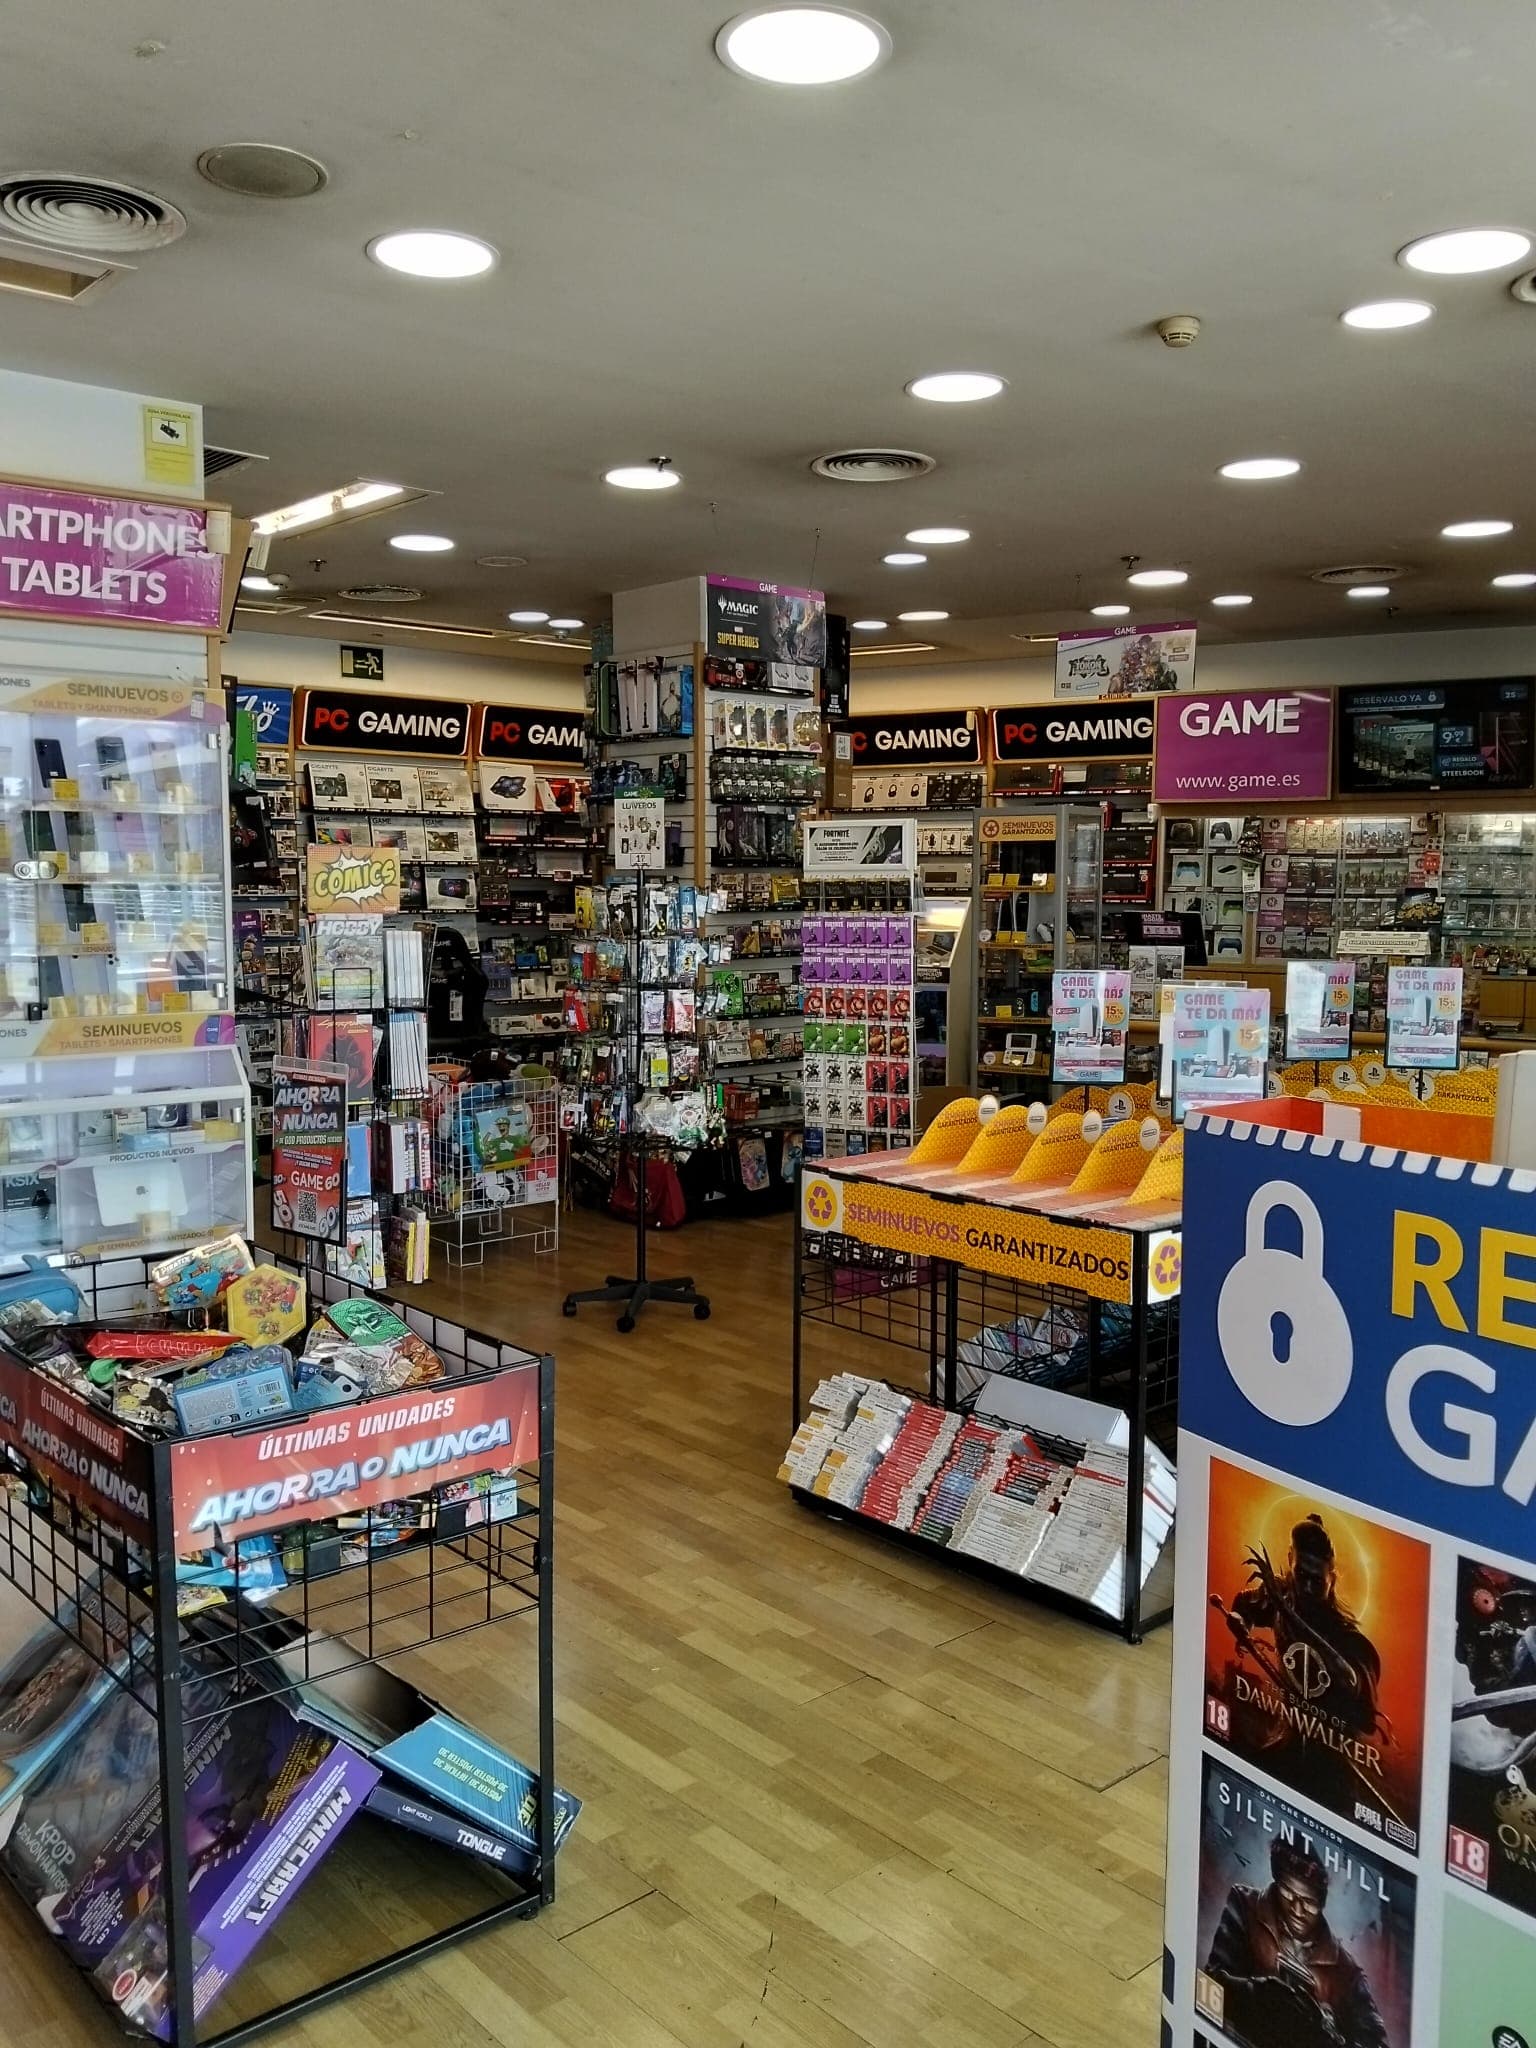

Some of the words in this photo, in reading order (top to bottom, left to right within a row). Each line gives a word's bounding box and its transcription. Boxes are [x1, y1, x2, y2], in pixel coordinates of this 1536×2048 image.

[1, 556, 167, 605] TABLETS
[759, 583, 778, 594] GAME
[727, 601, 759, 615] MAGIC
[717, 632, 737, 645] SUPER
[737, 635, 760, 649] HEROES
[1114, 626, 1137, 636] GAME
[67, 682, 169, 702] SEMINUEVOS
[1409, 693, 1422, 703] YA
[84, 703, 160, 716] SMARTPHONES
[1179, 698, 1301, 737] GAME
[314, 707, 349, 731] PC
[358, 711, 461, 739] GAMING
[490, 721, 521, 744] PC
[1004, 723, 1037, 744] PC
[1046, 717, 1154, 743] GAMING
[852, 731, 868, 751] C
[875, 727, 971, 751] GAMING
[1176, 774, 1301, 792] www.game.es
[823, 829, 850, 838] FORTNITE
[1001, 828, 1054, 836] GARANTIZADOS
[1002, 820, 1054, 829] SEMINUEVOS
[314, 859, 397, 897] COMICS
[1061, 976, 1094, 987] GAME
[1396, 970, 1427, 980] GAME
[1062, 988, 1075, 999] TE
[1079, 988, 1096, 999] DA
[1397, 981, 1409, 991] TE
[1413, 981, 1429, 991] DA
[1183, 993, 1225, 1006] GAME
[1185, 1007, 1201, 1020] TE
[1206, 1007, 1227, 1020] DA
[1231, 1004, 1262, 1020] MÁS
[82, 1021, 183, 1038] SEMINUEVOS
[109, 1034, 184, 1048] SMARTPHONES
[1080, 1070, 1099, 1078] GAME
[1285, 1075, 1331, 1084] GARANTIZDOS
[275, 1085, 341, 1106] AHORRA
[282, 1112, 339, 1131] NUNCA
[296, 1134, 327, 1145] PRODUCTOS
[109, 1150, 160, 1162] PRODUCTOS
[161, 1147, 195, 1158] NUEVOS
[6, 1173, 40, 1188] KSIX
[290, 1170, 324, 1191] GAME
[848, 1203, 961, 1243] SEMINUEVOS
[965, 1228, 1129, 1281] GARANTIZADOS
[1391, 1209, 1536, 1350] RE
[40, 1387, 75, 1427] ÚLTIMAS
[76, 1413, 120, 1457] UNIDADES
[258, 1422, 352, 1461] ÚLTIMAS
[358, 1397, 455, 1439] UNIDADES
[22, 1418, 78, 1474] AHORRA
[90, 1460, 150, 1520] NUNCA
[190, 1461, 361, 1534] AHORRA
[389, 1417, 511, 1478] NUNCA
[1265, 1680, 1285, 1698] THE
[1289, 1692, 1328, 1721] BLOOD
[1330, 1715, 1347, 1729] OF
[1206, 1699, 1229, 1732] 18
[1235, 1674, 1384, 1777] DAWNWALKER
[402, 1804, 416, 1816] LIGHT
[416, 1810, 433, 1823] WORLD
[1258, 1790, 1277, 1804] DAY
[1280, 1802, 1299, 1818] ONE
[1303, 1817, 1344, 1845] EDITION
[16, 1821, 43, 1863] DEMON
[35, 1819, 76, 1865] KPOP
[456, 1829, 507, 1861] TONGUE
[1218, 1782, 1314, 1857] SILENT
[1325, 1846, 1391, 1903] HILL
[245, 1786, 353, 1927] MINECRAFT
[1452, 1833, 1485, 1875] 18
[1199, 1976, 1222, 2014] 16
